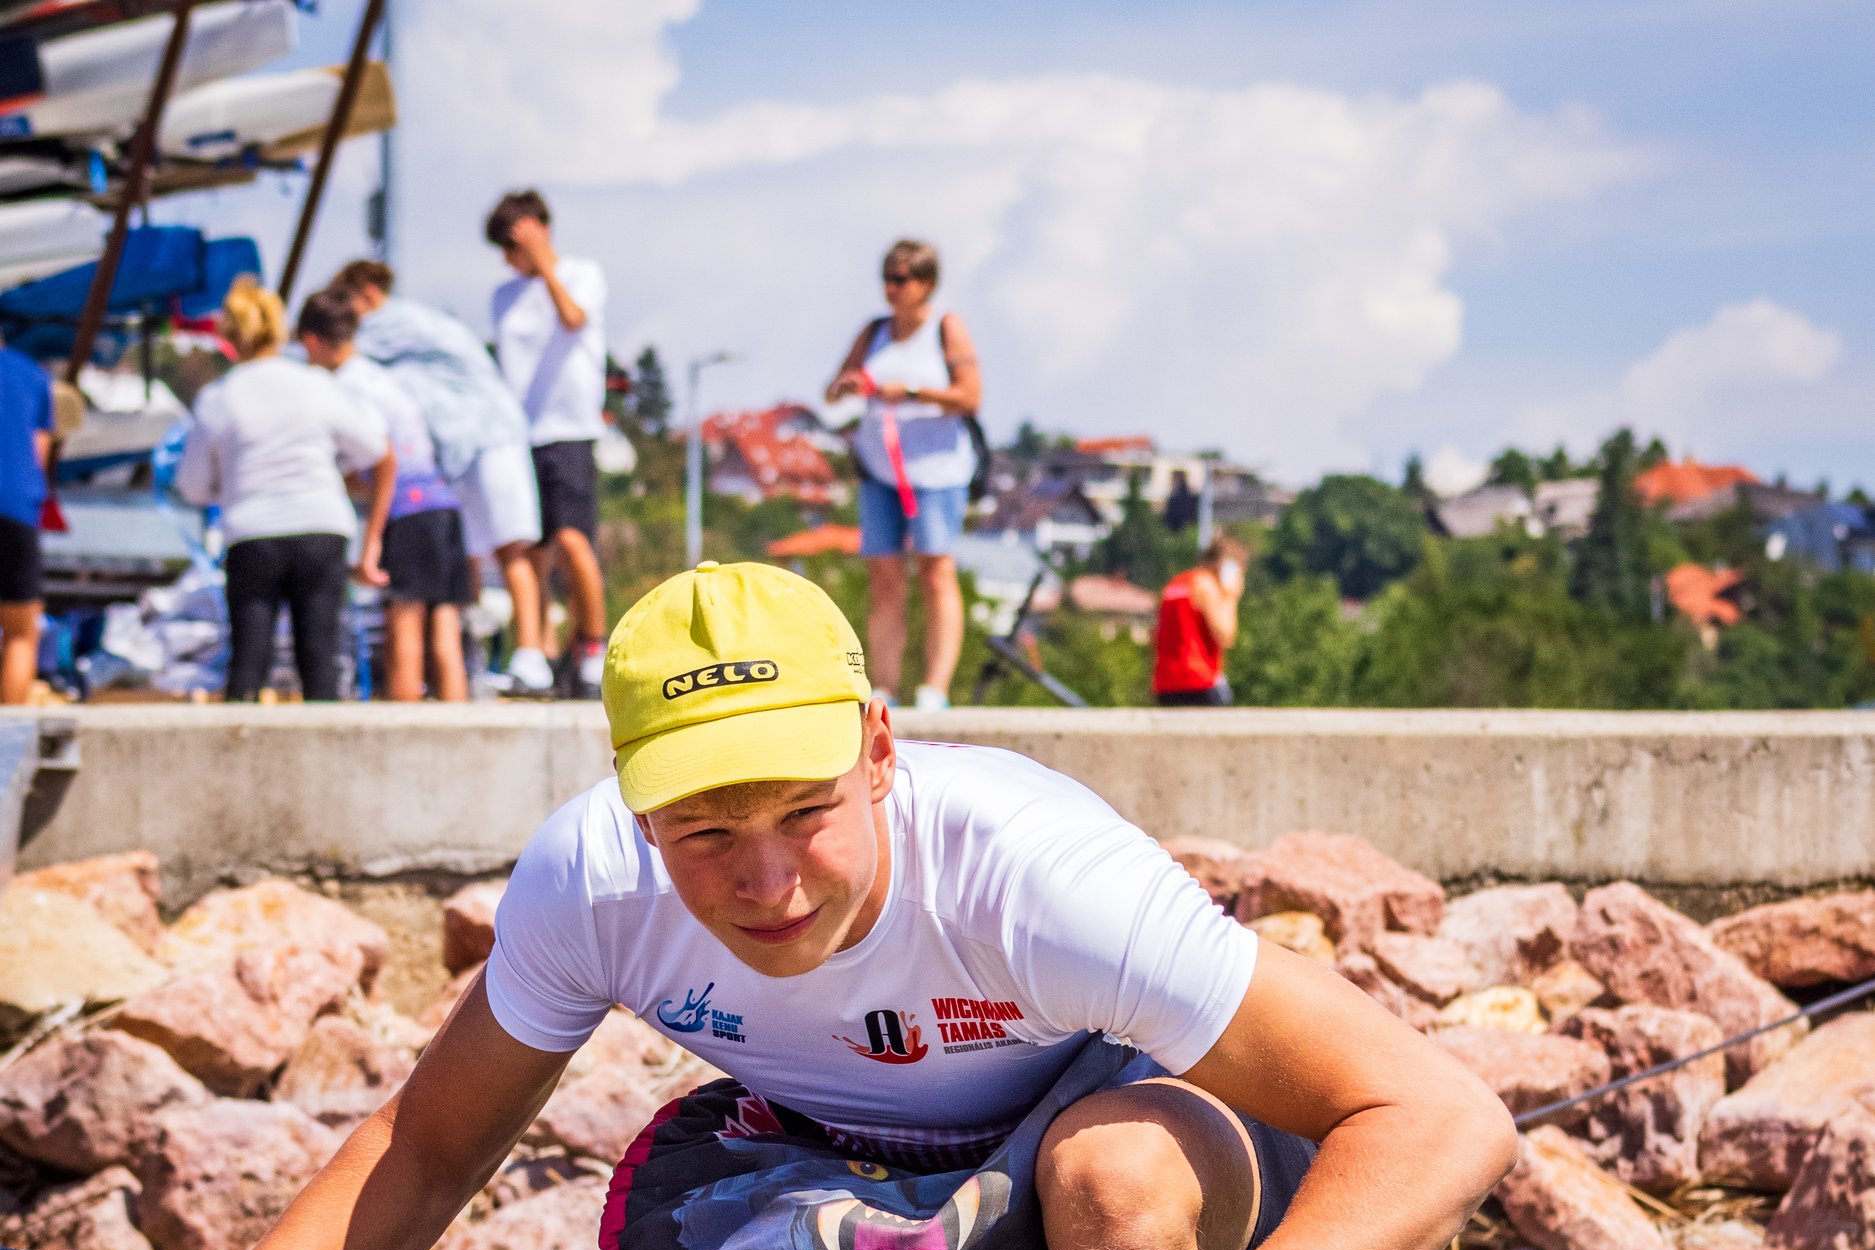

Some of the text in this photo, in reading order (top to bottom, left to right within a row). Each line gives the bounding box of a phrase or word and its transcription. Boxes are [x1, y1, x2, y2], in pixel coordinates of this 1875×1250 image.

[666, 662, 777, 698] NELO
[711, 1008, 744, 1026] KAJAK
[931, 998, 1024, 1021] WICHMNN
[711, 1019, 738, 1033] KENU
[937, 1019, 1007, 1043] TAMÁS
[712, 1029, 746, 1043] SPORT
[944, 1041, 994, 1055] REGIONÁLIS
